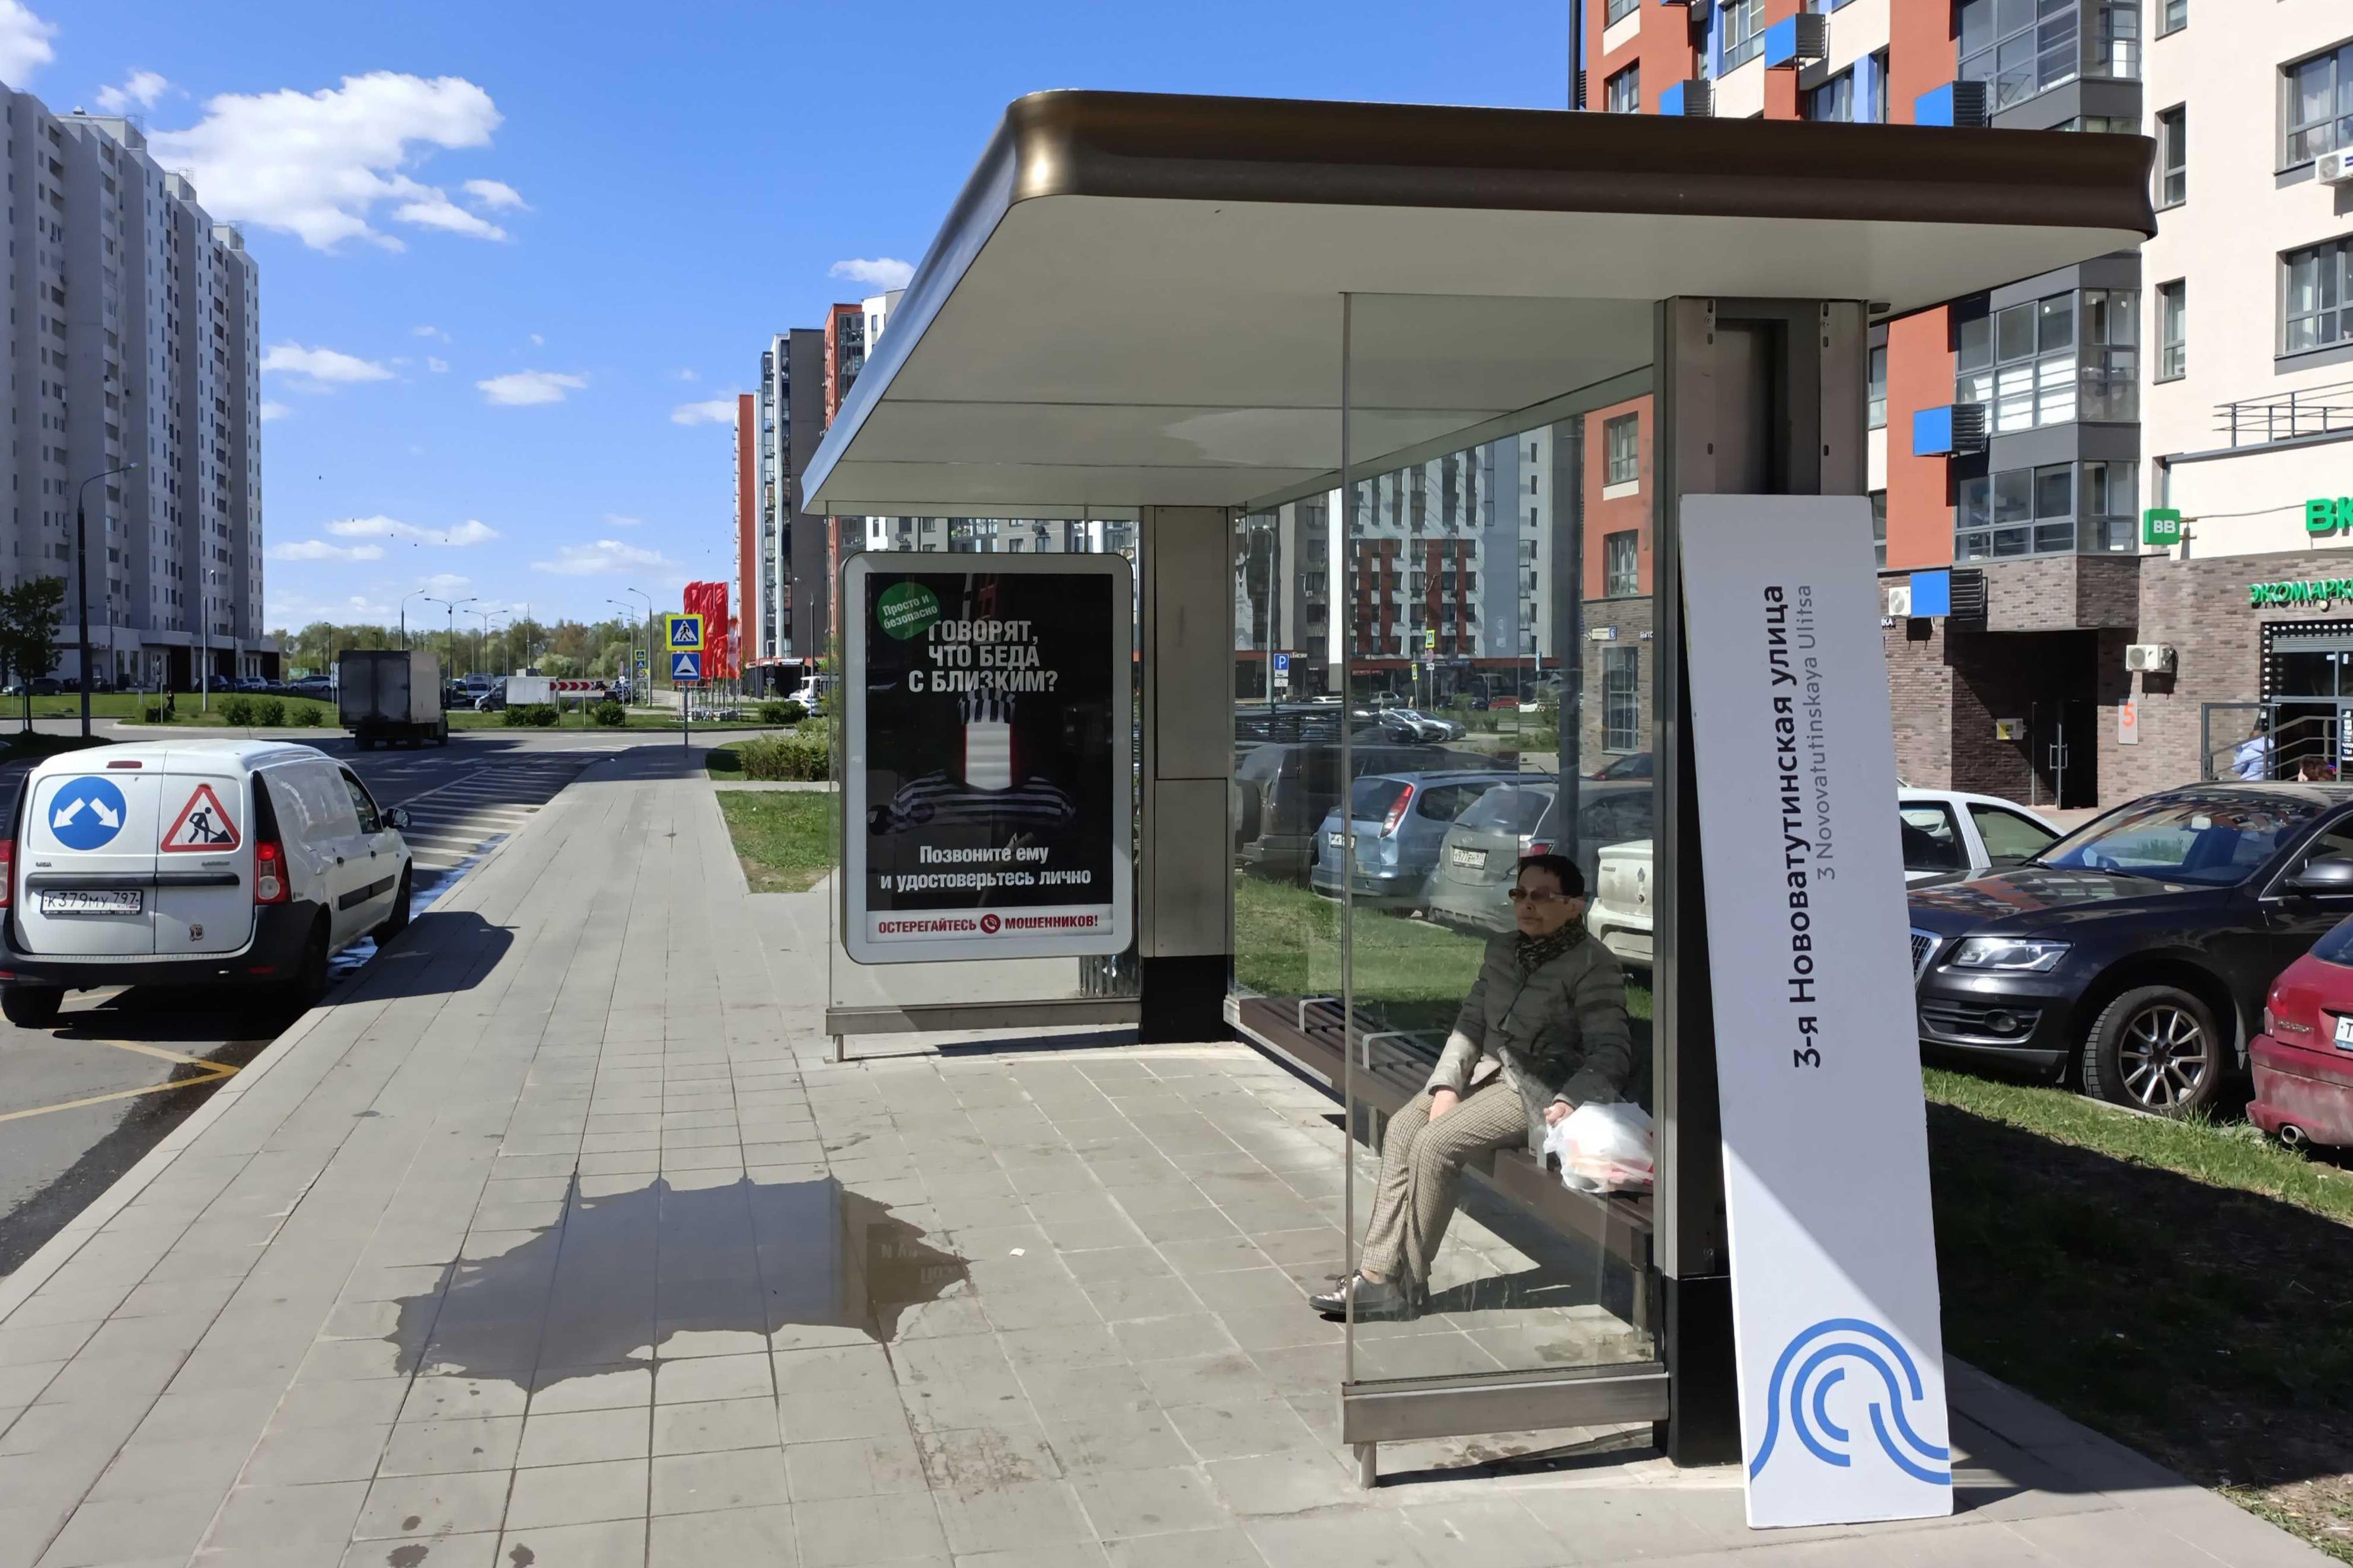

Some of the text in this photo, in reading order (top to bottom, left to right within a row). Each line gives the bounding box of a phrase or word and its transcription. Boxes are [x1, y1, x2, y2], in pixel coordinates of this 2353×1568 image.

[2153, 520, 2176, 533] ВВ
[2248, 577, 2353, 602] ЭКОМАРК
[882, 595, 930, 617] Просто и
[883, 605, 938, 630] безопасно
[928, 620, 1038, 644] ГОВОРЯТ,
[928, 645, 1040, 670] ЧТО БЕДА
[908, 670, 1058, 693] С БЛИЗКИМ?
[2122, 702, 2135, 727] 5
[1796, 585, 1836, 881] 3 Novovatutinskaya Ulitsa
[1764, 586, 1821, 1069] 3-я Нововатутинская улица
[920, 845, 1049, 864] Позвоните ему
[881, 870, 1092, 893] и удостоверьтесь лично
[878, 915, 1098, 934] ОСТЕРЕГАЙТЕСЬ МОШЕННИКОВ!
